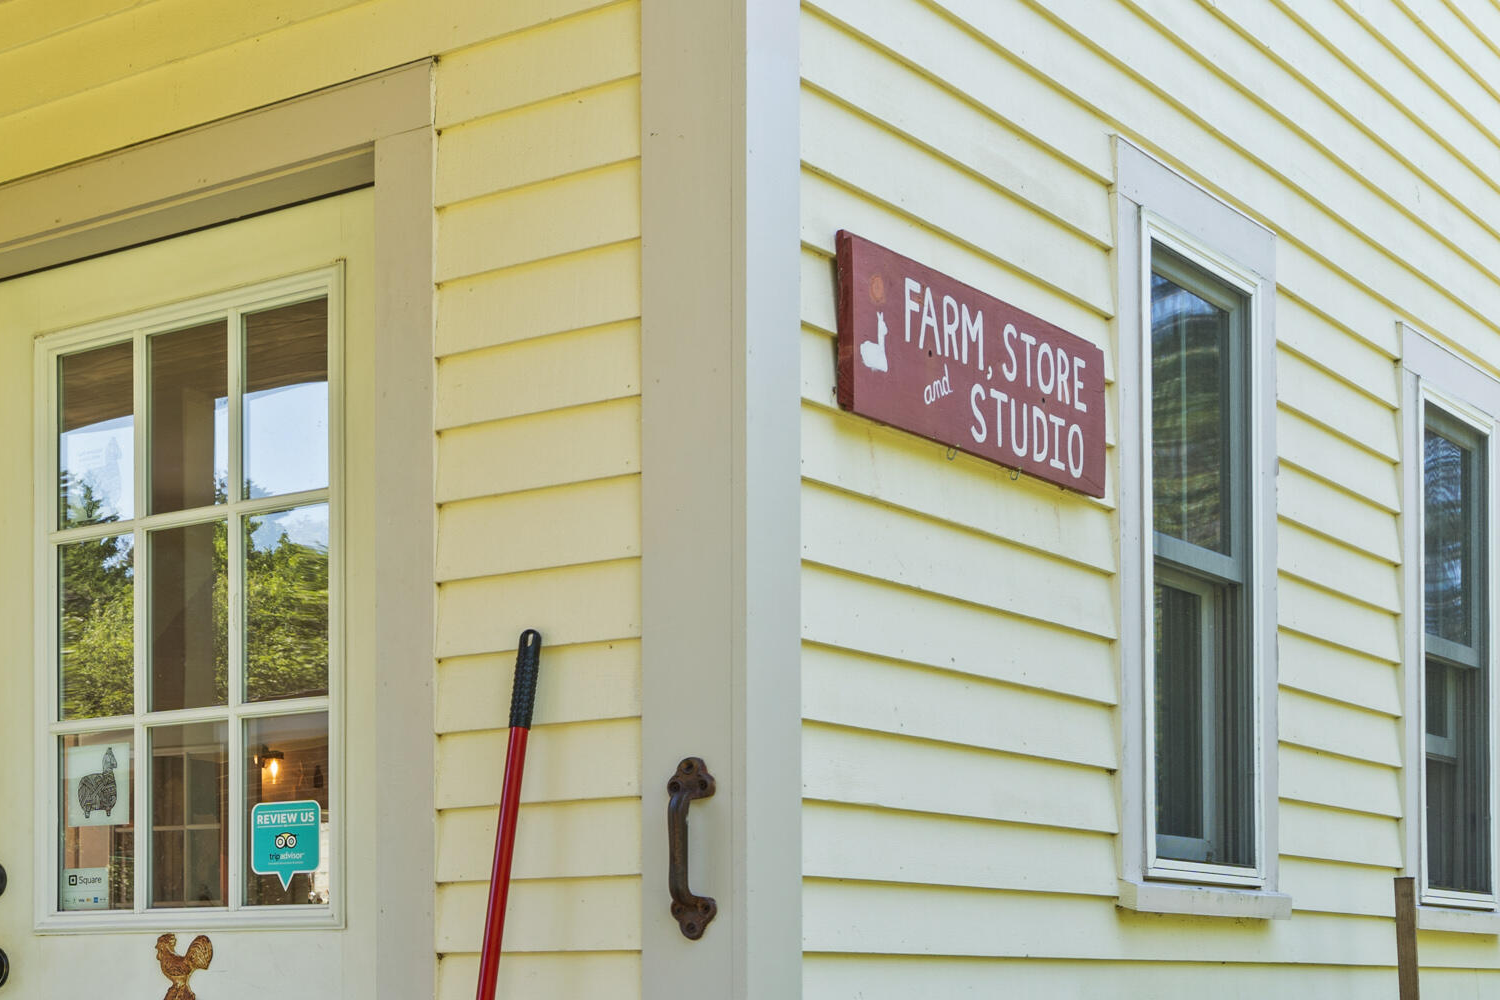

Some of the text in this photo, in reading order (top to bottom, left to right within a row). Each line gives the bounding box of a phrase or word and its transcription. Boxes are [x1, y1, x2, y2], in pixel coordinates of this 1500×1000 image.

[1002, 323, 1087, 413] STORE
[923, 364, 1084, 479] and STUDIO
[257, 811, 315, 825] REVIEW US
[269, 851, 304, 861] tripadvisor
[78, 876, 102, 885] Square
